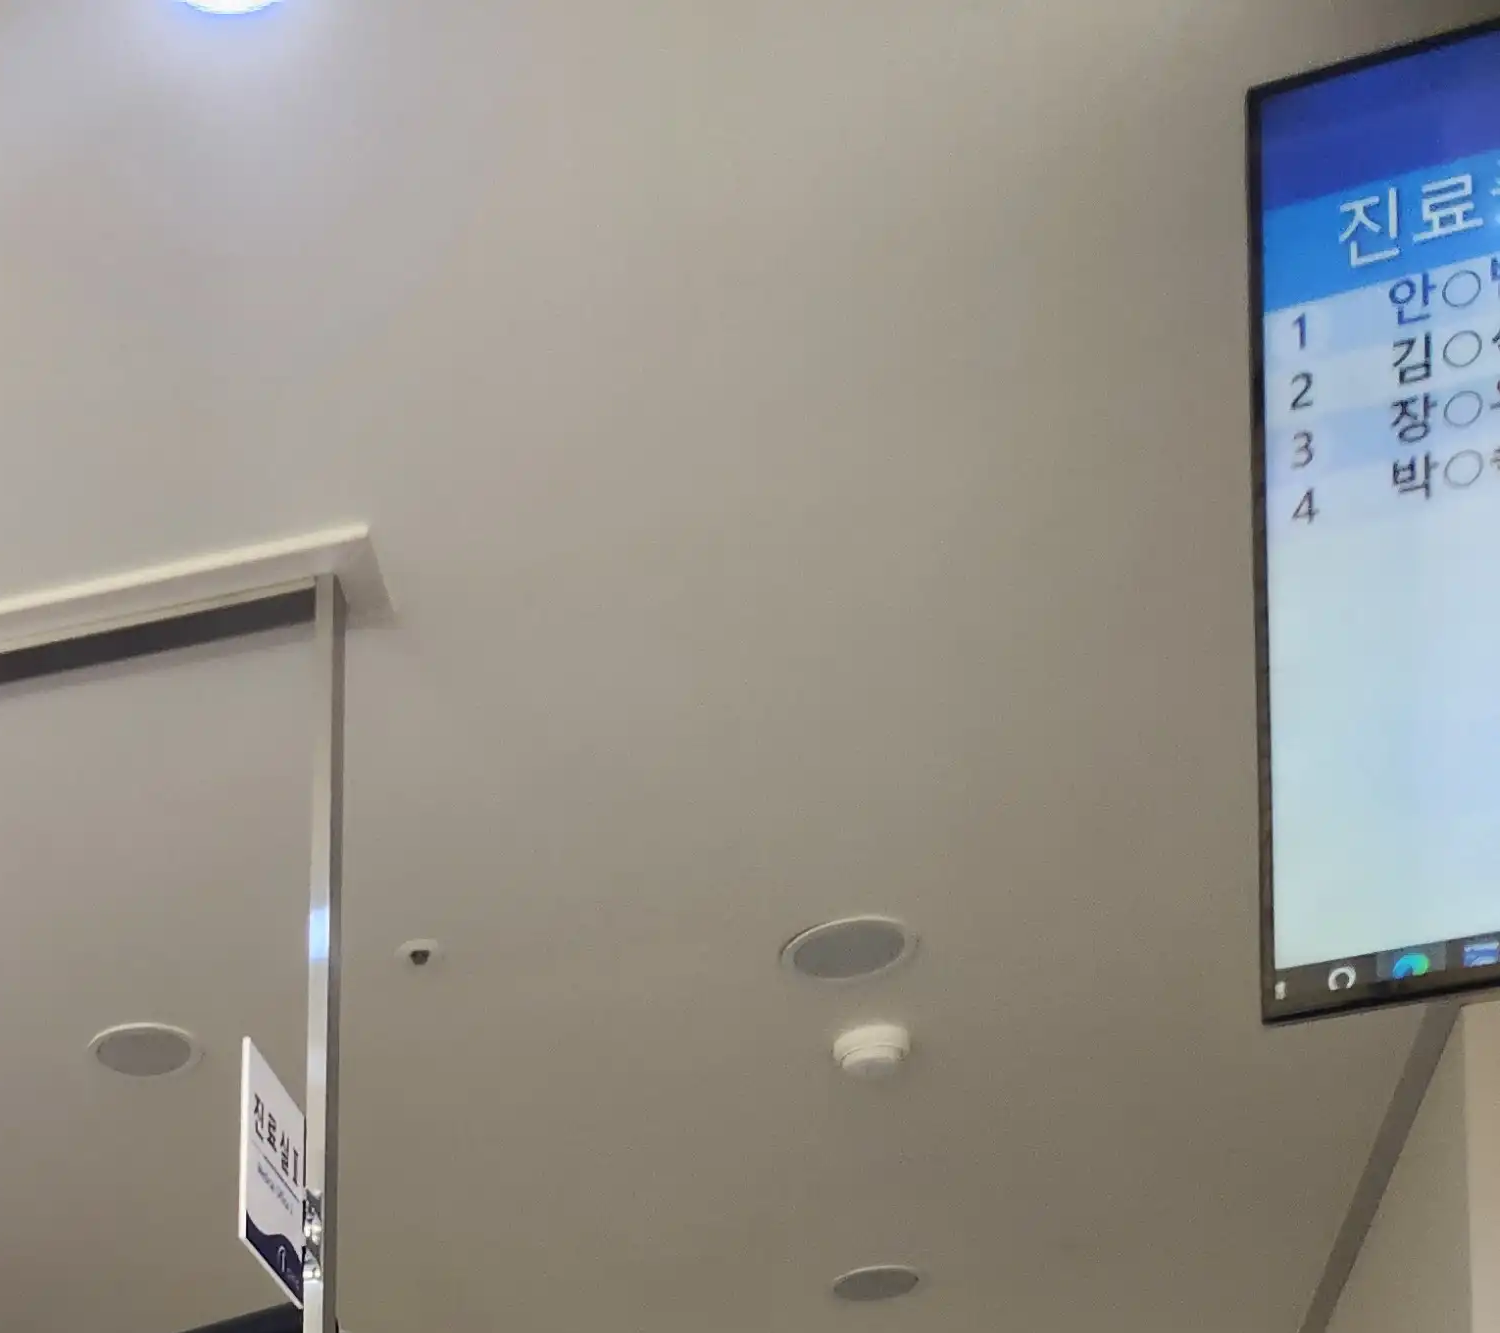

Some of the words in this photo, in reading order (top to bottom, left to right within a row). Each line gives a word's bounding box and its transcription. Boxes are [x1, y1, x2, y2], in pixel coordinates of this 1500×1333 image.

[1338, 158, 1500, 269] 진료
[1292, 311, 1307, 350] 1
[1290, 371, 1314, 412] 2
[1291, 429, 1314, 469] 3
[1291, 486, 1320, 525] 4
